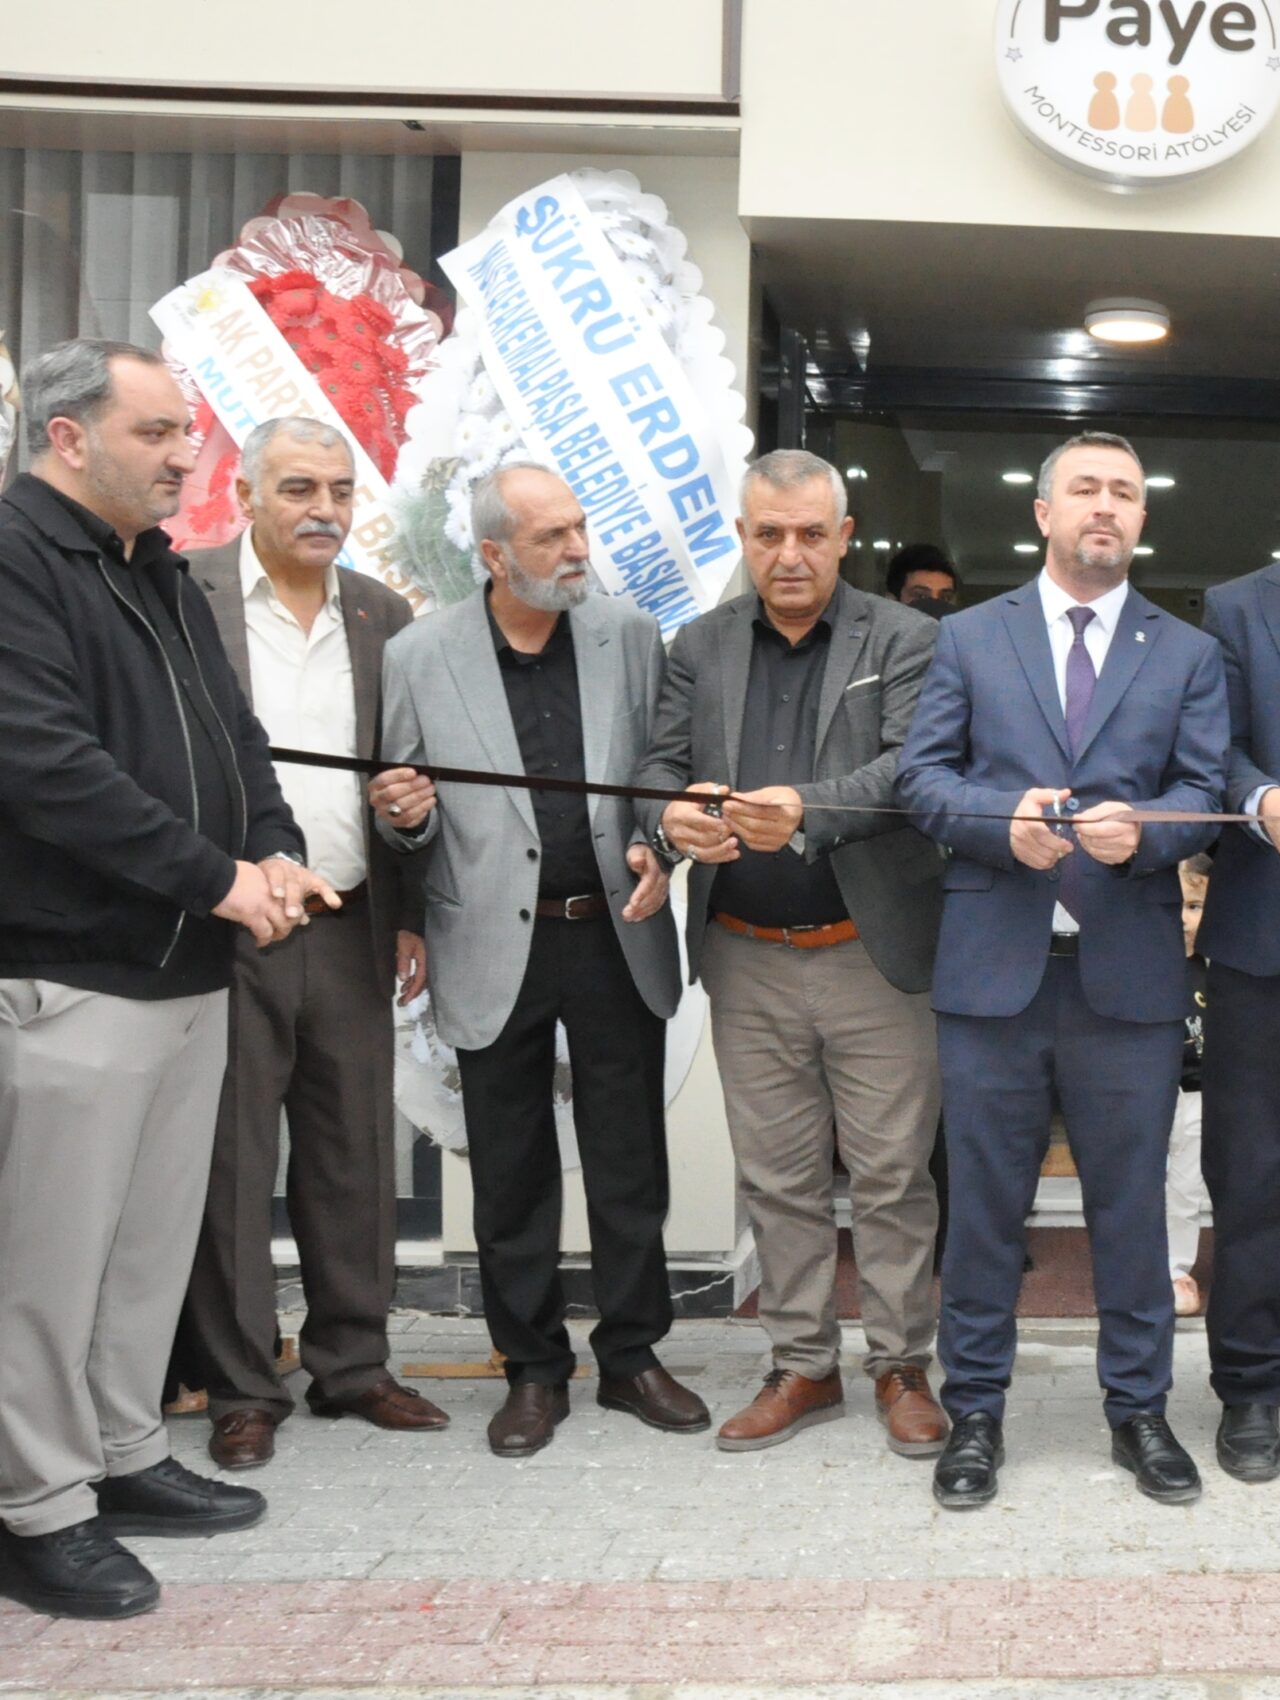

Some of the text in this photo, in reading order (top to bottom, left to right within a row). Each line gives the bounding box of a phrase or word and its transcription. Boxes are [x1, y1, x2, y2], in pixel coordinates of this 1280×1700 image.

[1045, 0, 1257, 66] Paye
[1024, 85, 1257, 161] MONTESSORİ ATÖLYESİ
[209, 308, 259, 355] AK
[514, 195, 736, 568] ŞÜKRÜ ERDEM
[551, 422, 653, 546] BELEDİYE
